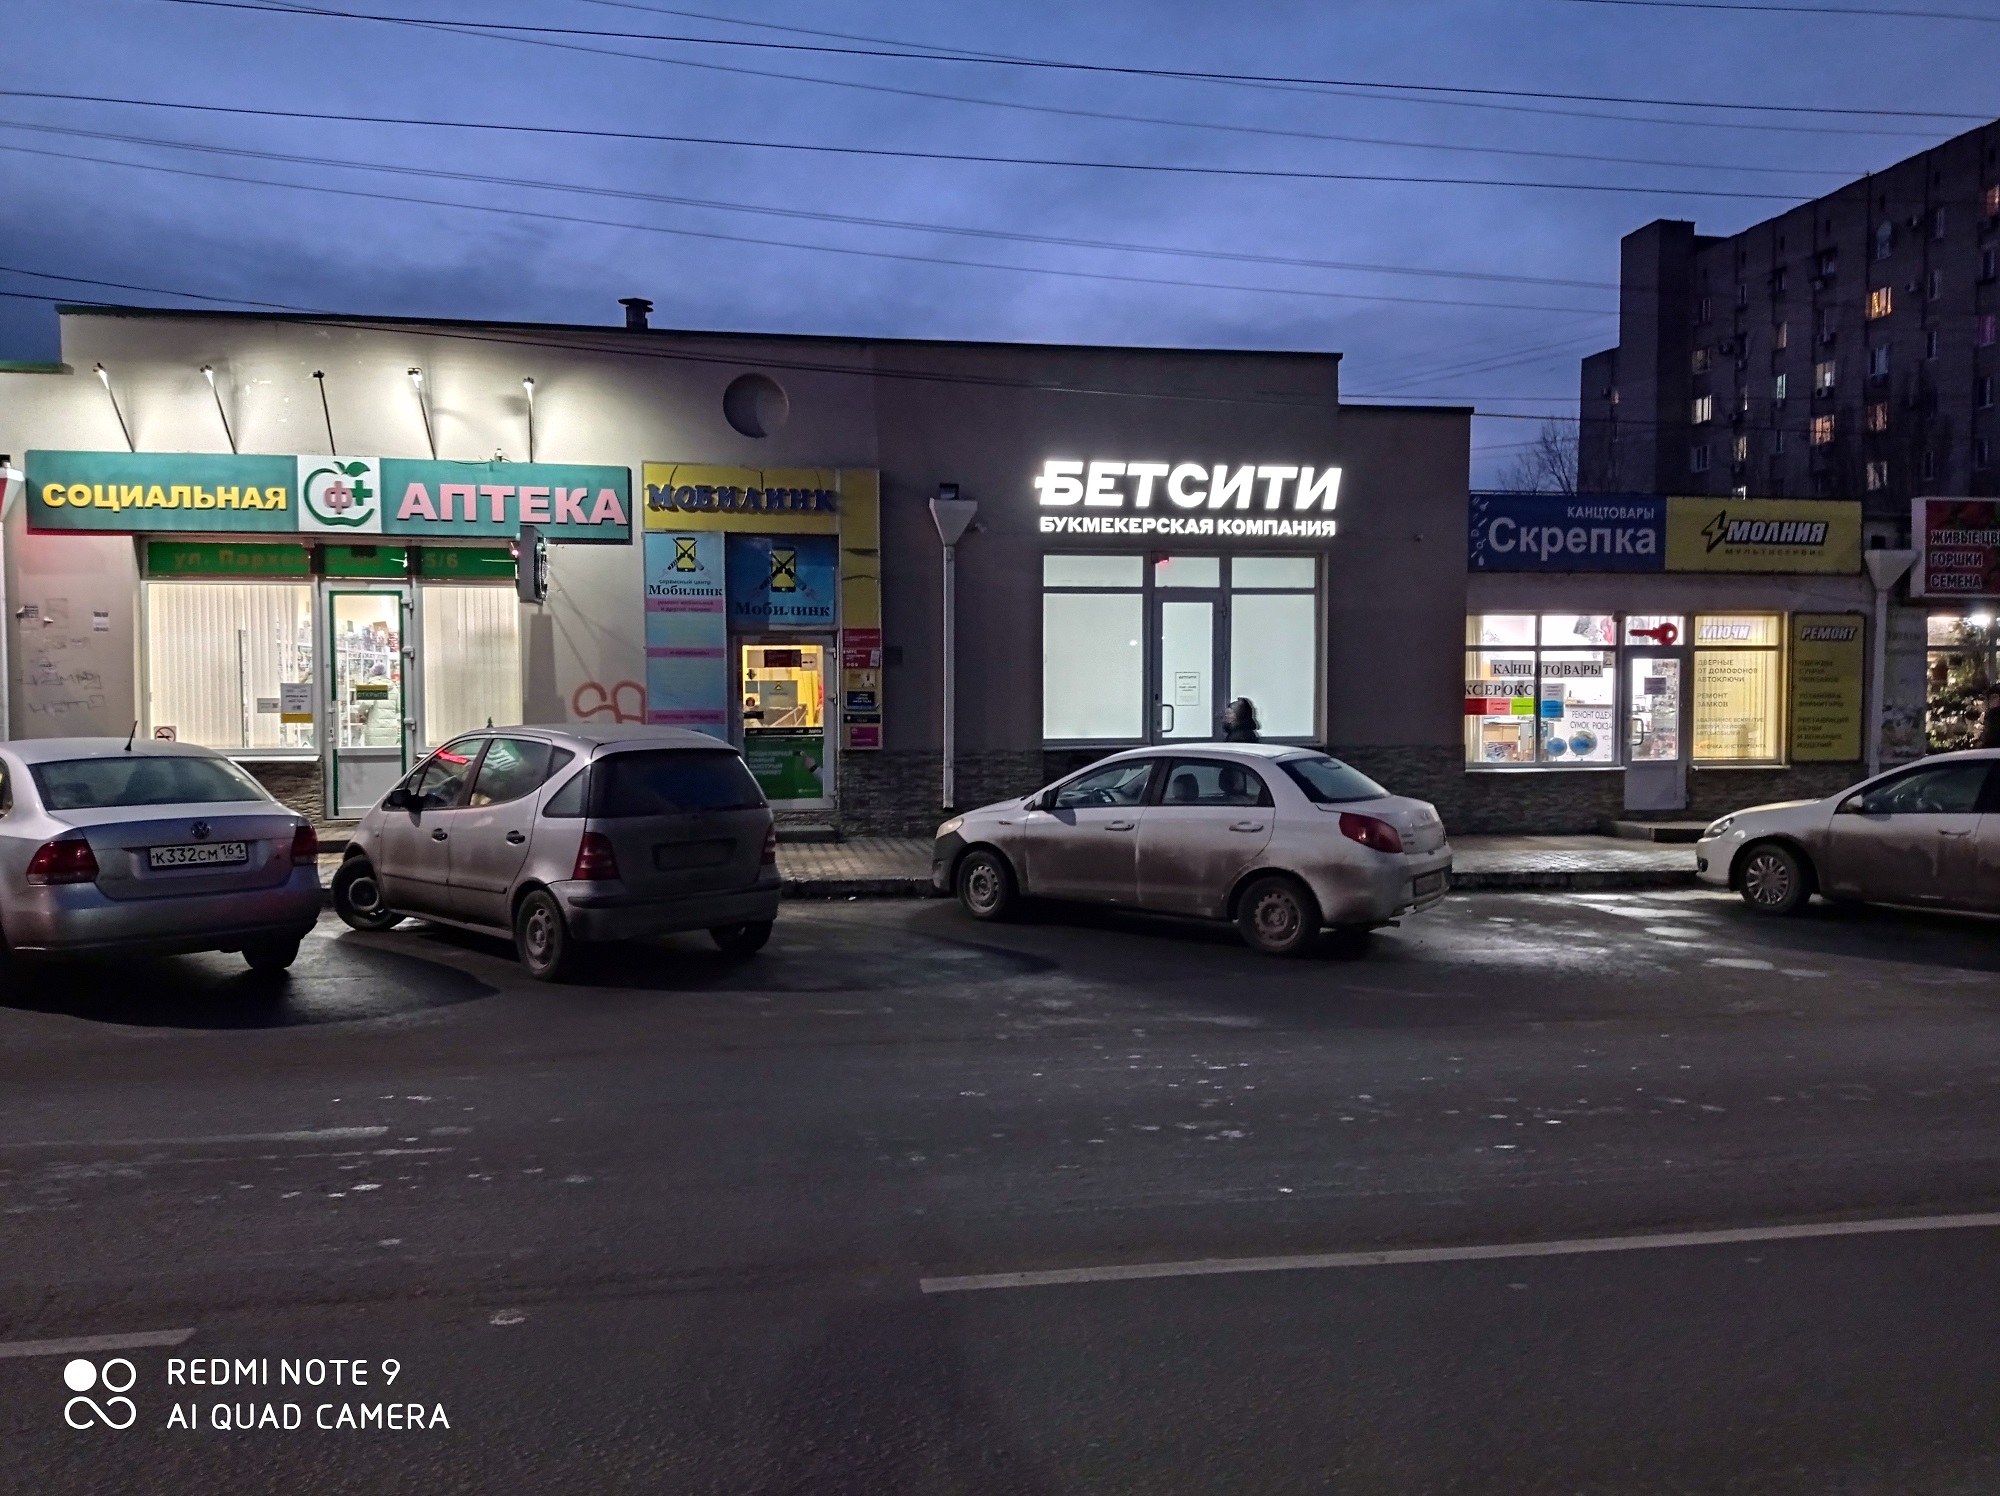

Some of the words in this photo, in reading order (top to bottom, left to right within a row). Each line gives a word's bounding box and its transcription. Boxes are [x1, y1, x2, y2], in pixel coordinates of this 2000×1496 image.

[1034, 460, 1343, 510] БЕТСИТИ
[42, 484, 287, 512] СОЦИАЛЬНАЯ
[396, 483, 629, 526] АПТЕКА
[647, 484, 838, 513] МОБИЛИНК
[1567, 506, 1655, 520] КАНЦТОВАРЫ
[1040, 516, 1214, 535] БУКМЕКЕРСКАЯ
[1218, 519, 1336, 537] КОМПАНИЯ
[1726, 520, 1828, 544] МОЛНИЯ
[1488, 516, 1656, 562] Скрепка
[1931, 530, 1980, 545] ЖИВЫЕ
[1931, 552, 1983, 567] ГОРШКИ
[1931, 573, 1982, 589] СЕМЕНА
[648, 584, 723, 597] Мобилинк
[735, 602, 830, 617] Мобилинк
[1698, 625, 1750, 639] КЛЮЧИ
[1801, 627, 1857, 640] РЕМОНТ
[221, 844, 245, 855] 161
